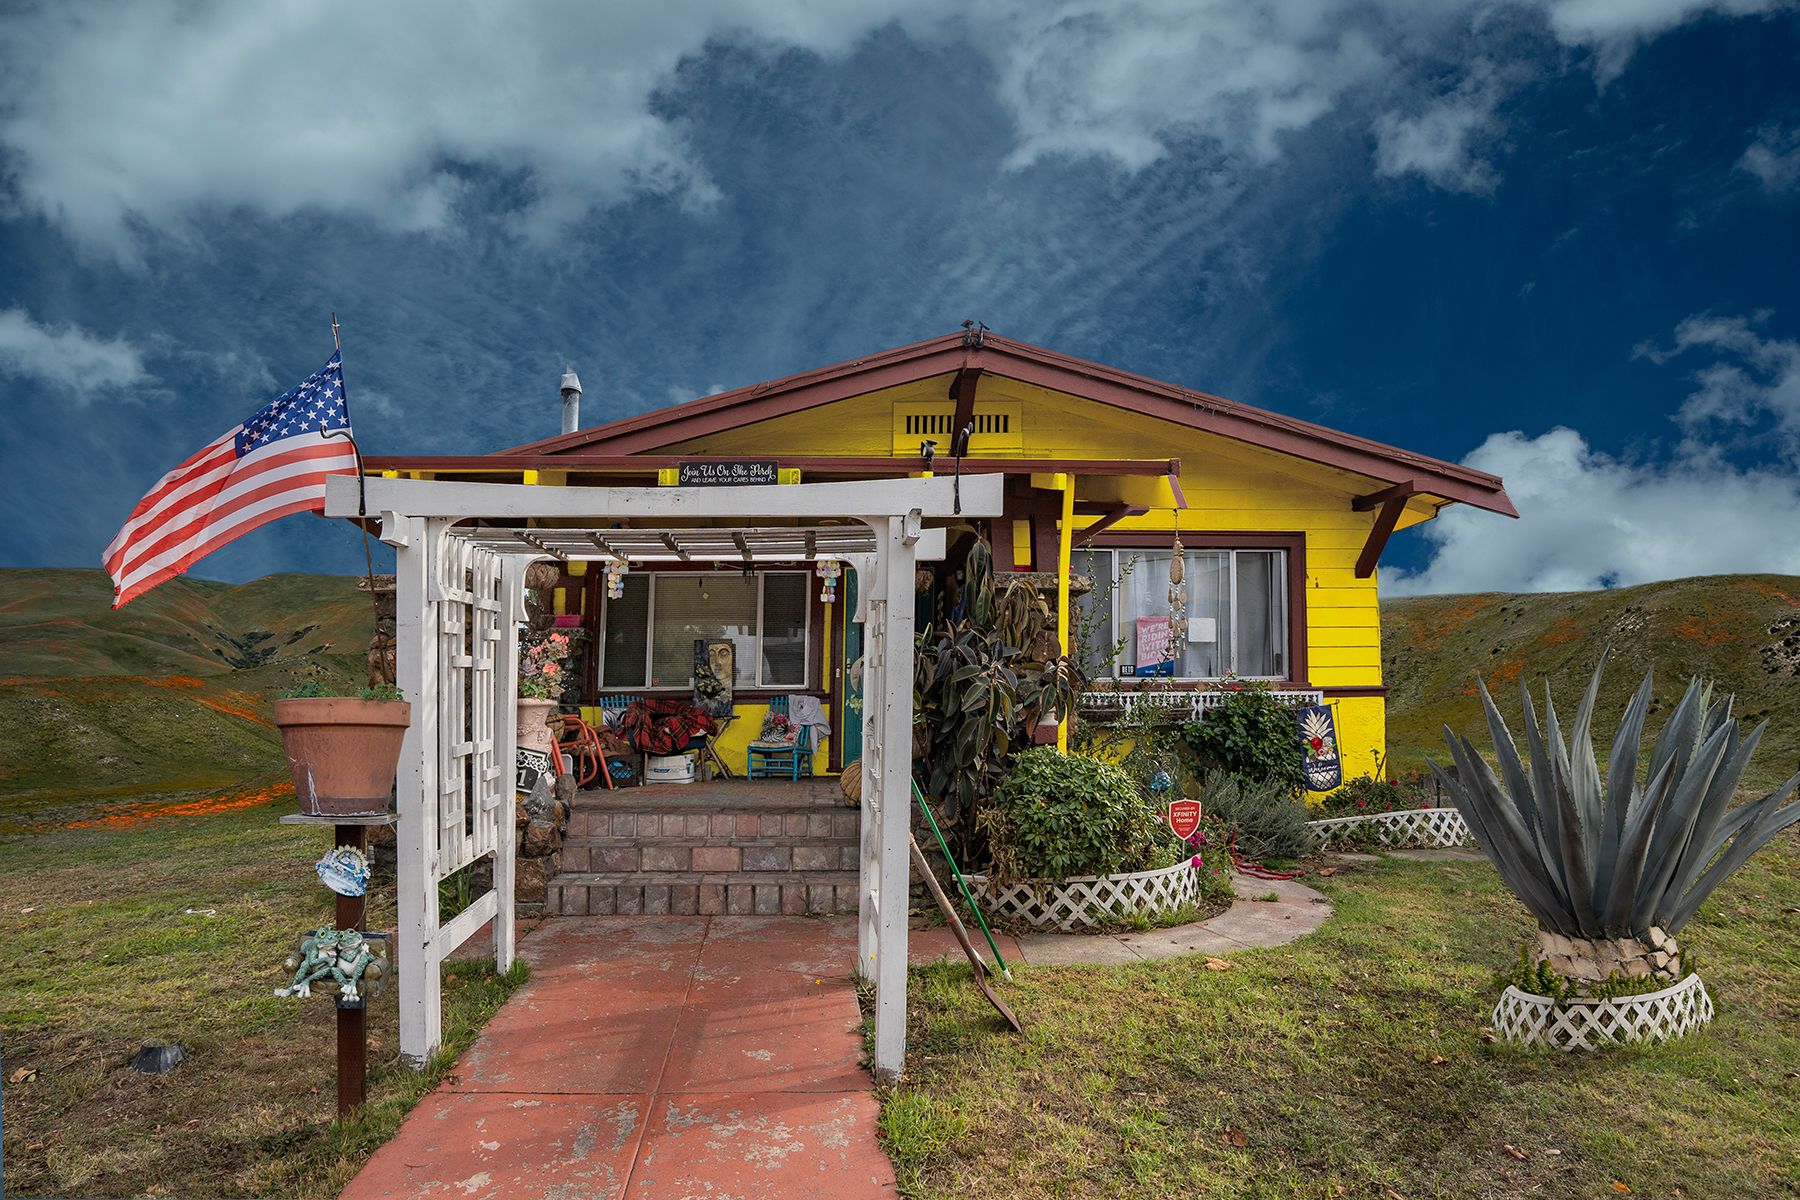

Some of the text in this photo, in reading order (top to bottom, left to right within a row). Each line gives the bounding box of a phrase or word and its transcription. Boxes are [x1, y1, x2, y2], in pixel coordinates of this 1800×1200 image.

[680, 463, 777, 482] Join Us On The Porch
[1141, 621, 1169, 633] WE'RE
[1142, 638, 1169, 652] WITH
